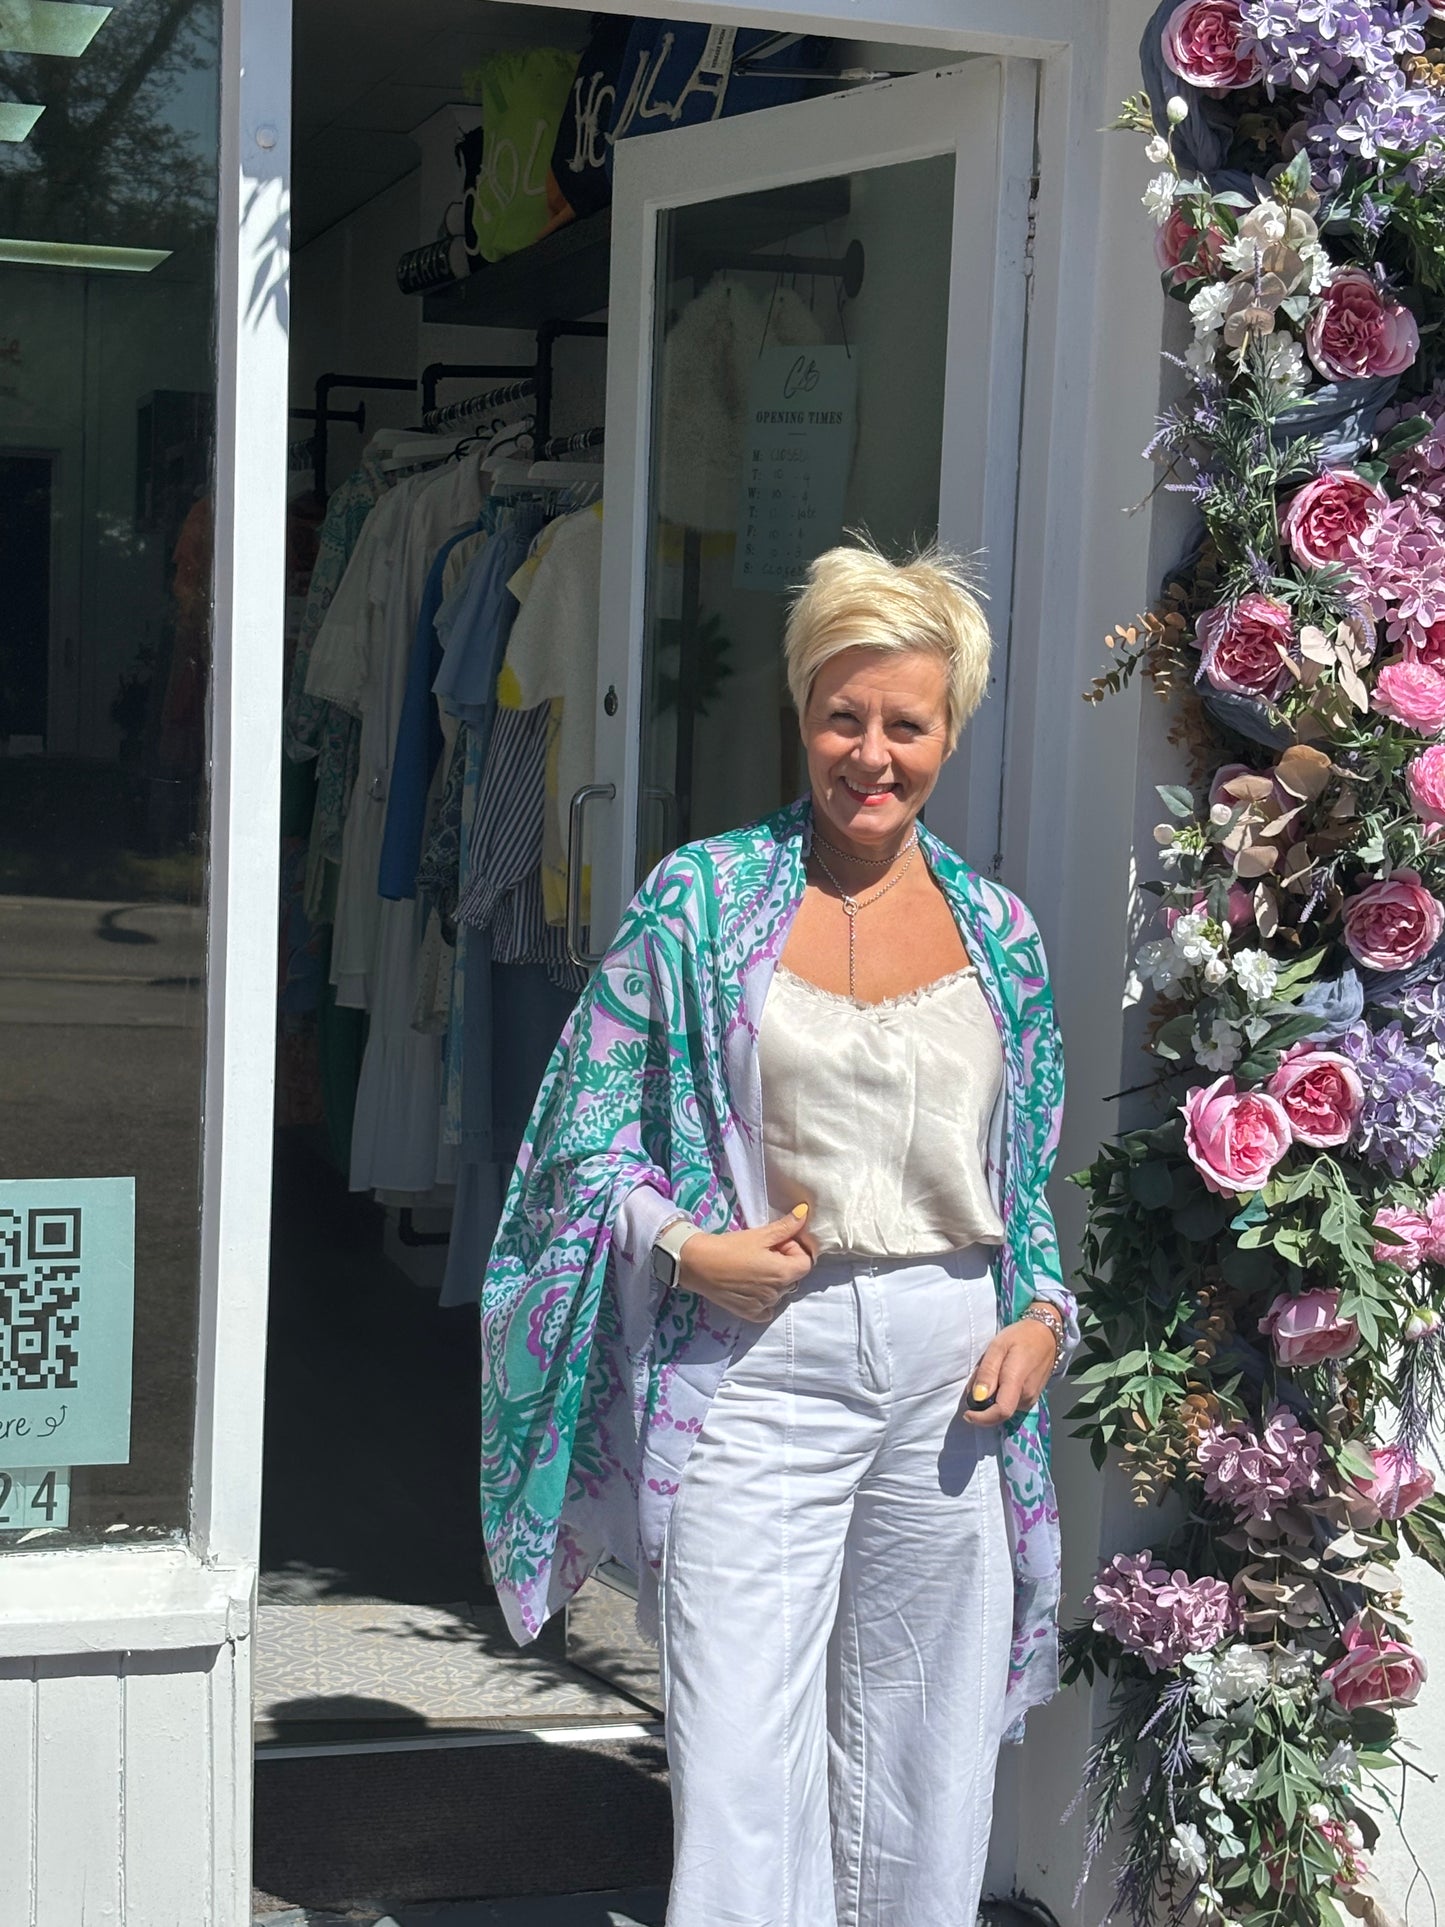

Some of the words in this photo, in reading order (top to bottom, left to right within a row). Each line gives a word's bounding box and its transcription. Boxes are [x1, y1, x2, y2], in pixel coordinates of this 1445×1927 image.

[755, 410, 805, 425] OPENING
[808, 410, 843, 425] TIMES
[747, 487, 760, 500] W:
